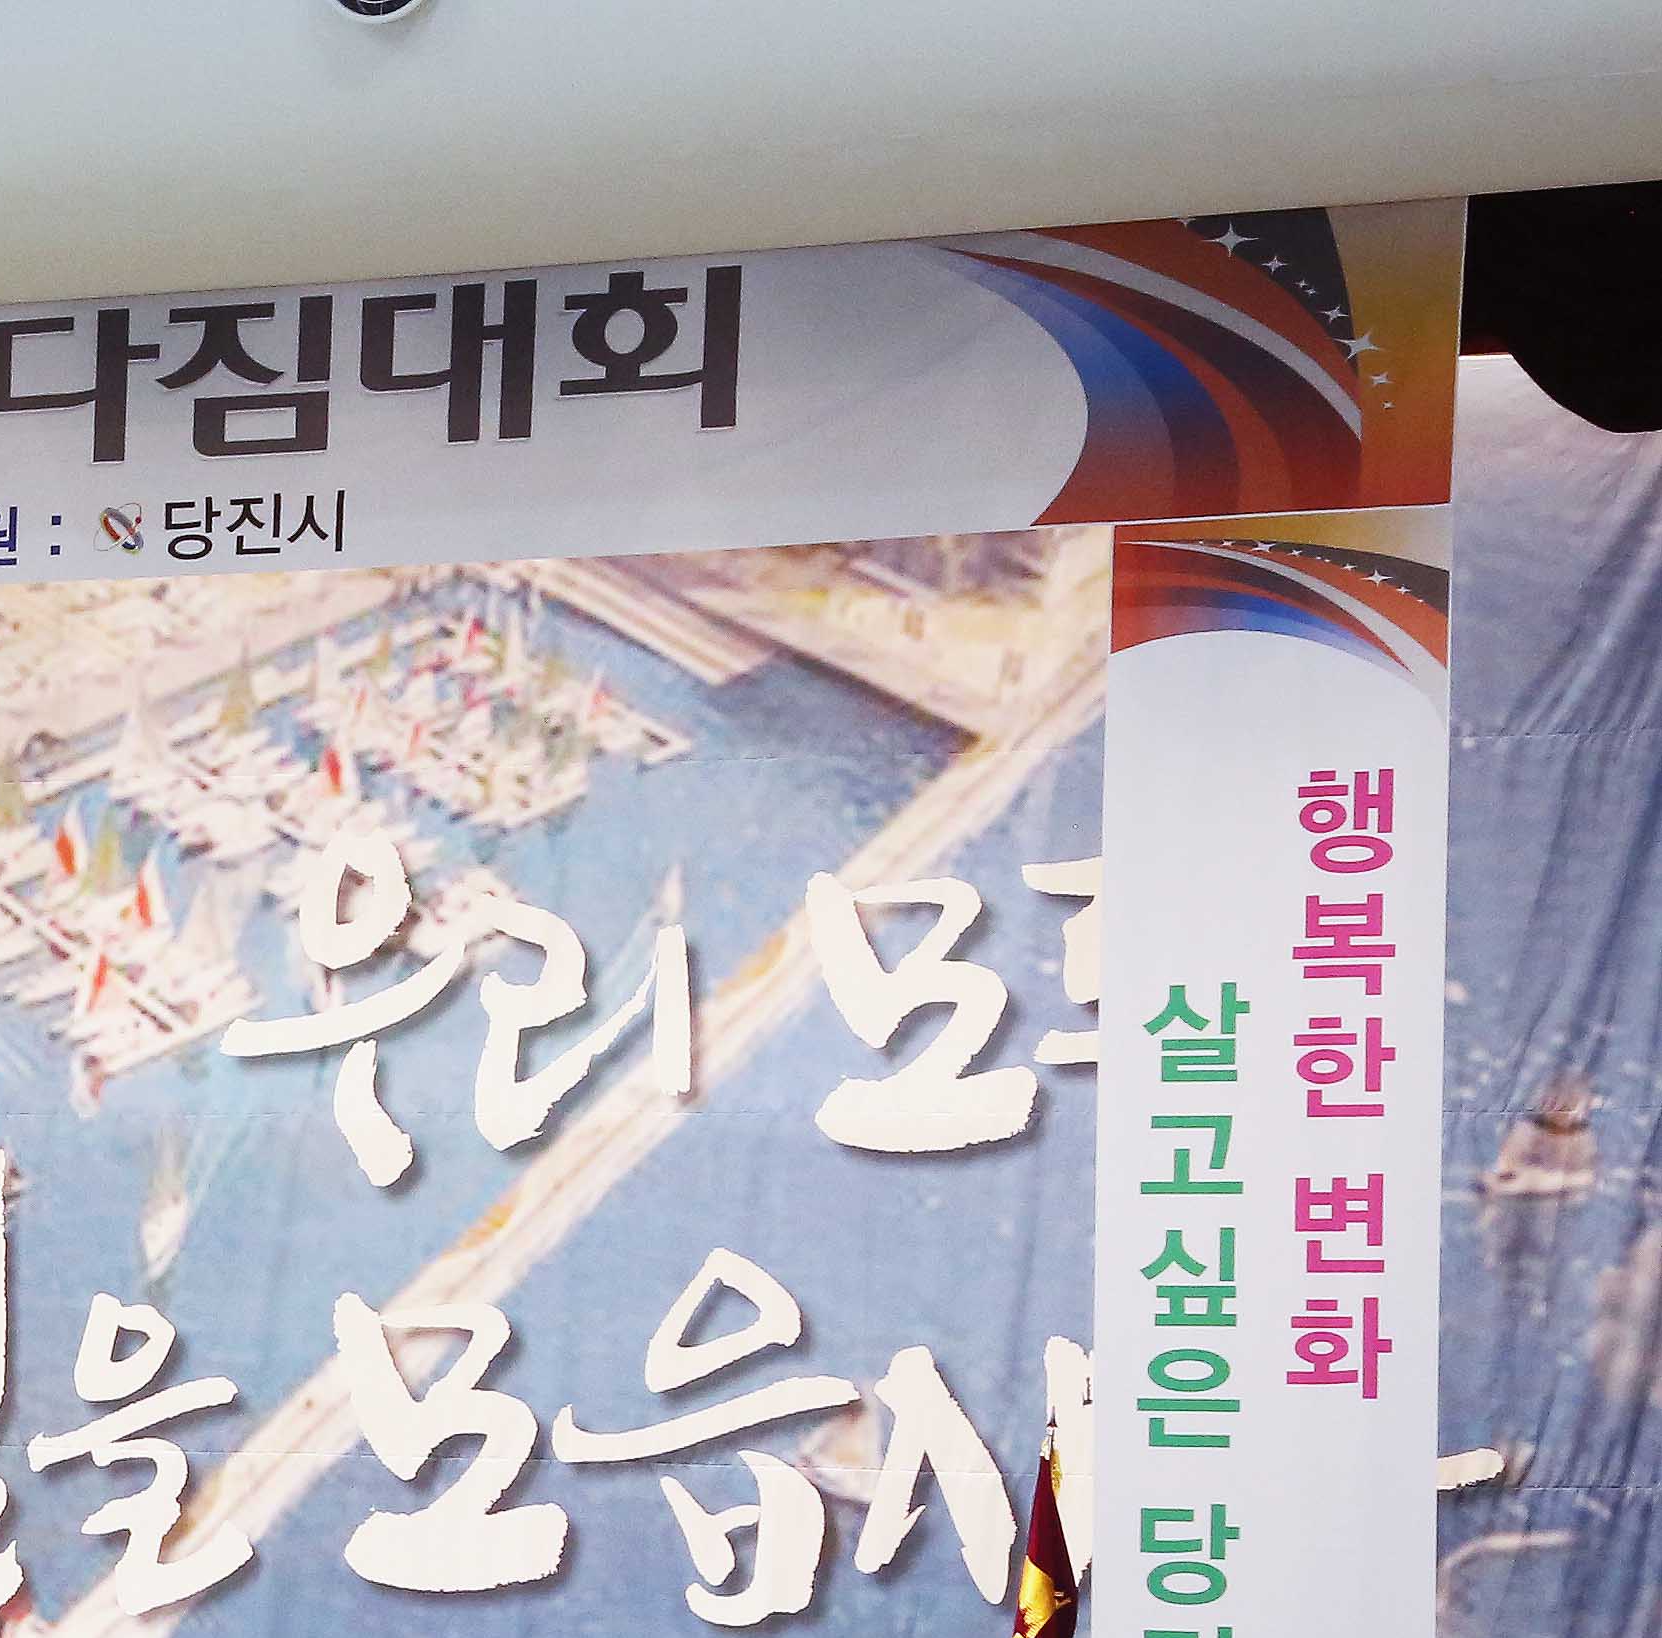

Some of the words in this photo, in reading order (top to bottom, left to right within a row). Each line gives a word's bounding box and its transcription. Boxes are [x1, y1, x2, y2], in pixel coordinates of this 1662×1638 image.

[164, 489, 347, 561] 당진시
[220, 826, 691, 1187] 우리
[1291, 768, 1397, 1118] 행복한
[1136, 981, 1251, 1449] 살고싶은
[1286, 1173, 1393, 1400] 변화
